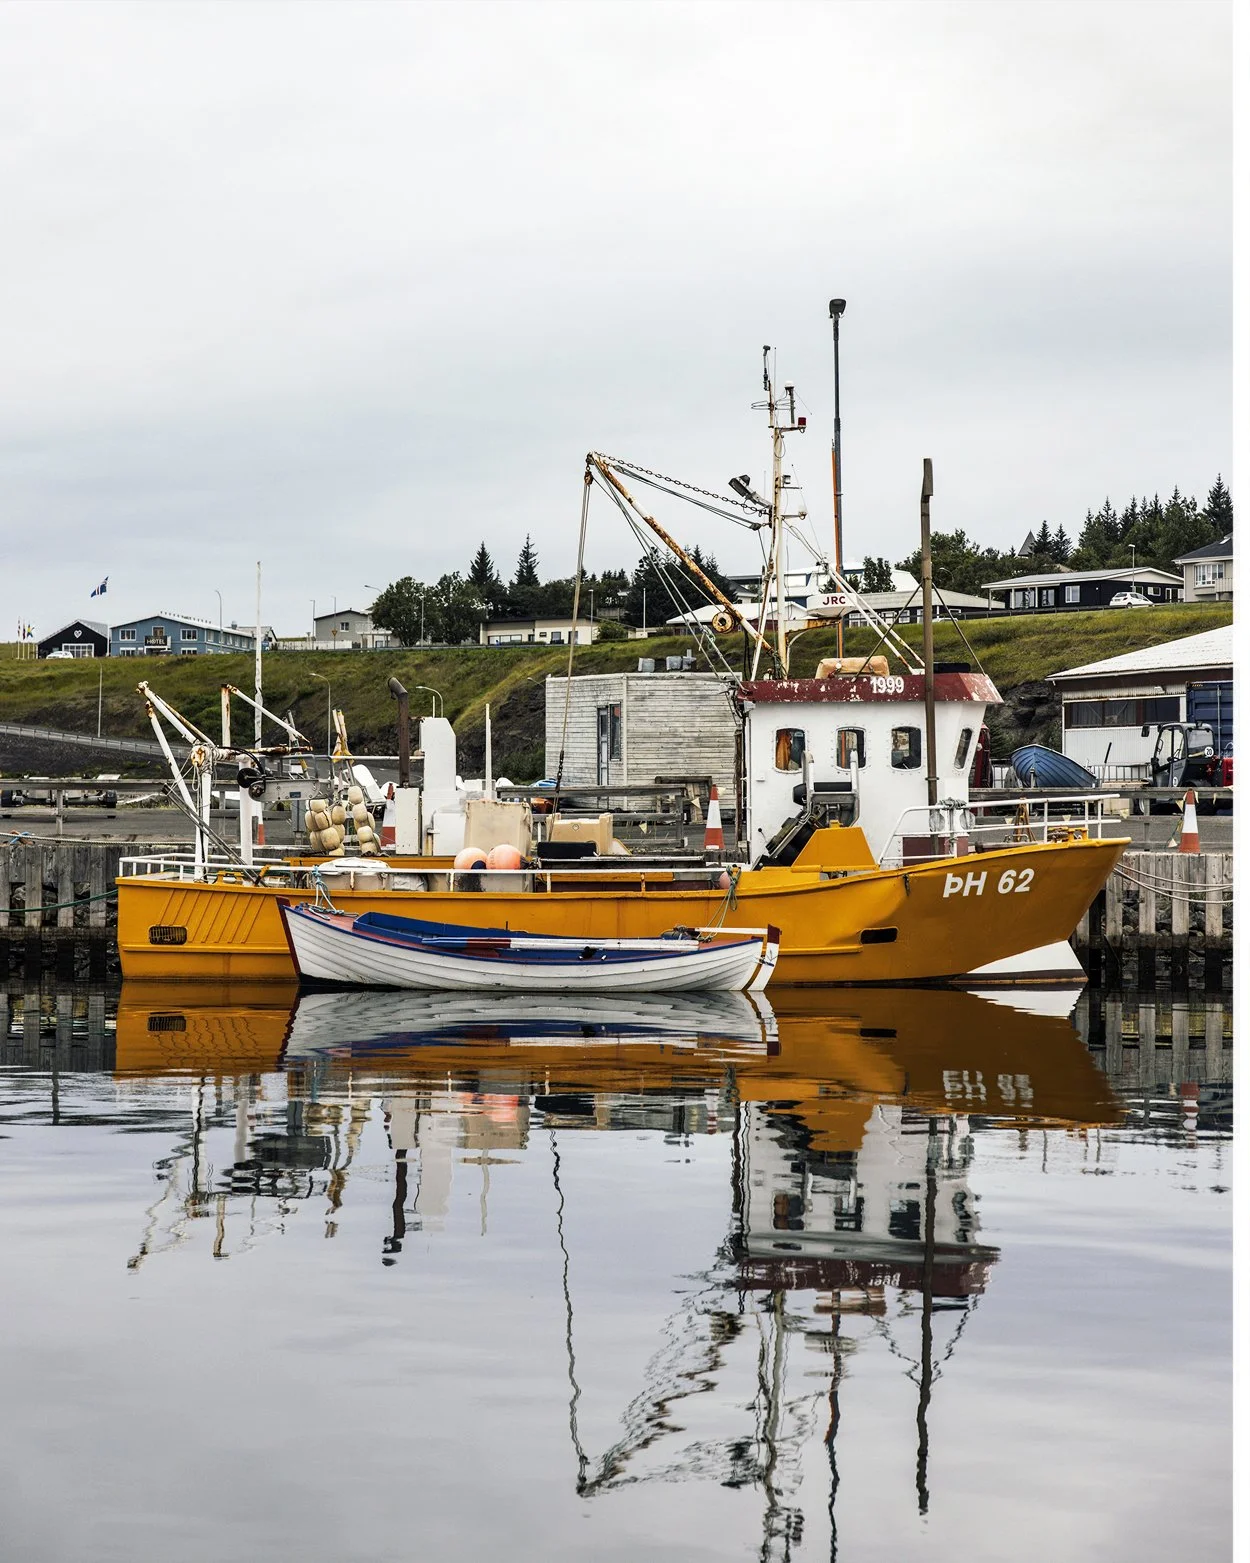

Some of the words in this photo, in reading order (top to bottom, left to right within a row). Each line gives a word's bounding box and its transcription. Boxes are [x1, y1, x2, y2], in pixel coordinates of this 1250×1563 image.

[822, 595, 847, 606] JRC
[870, 676, 905, 694] 1999
[942, 871, 988, 898] ÞH
[997, 867, 1035, 895] 62
